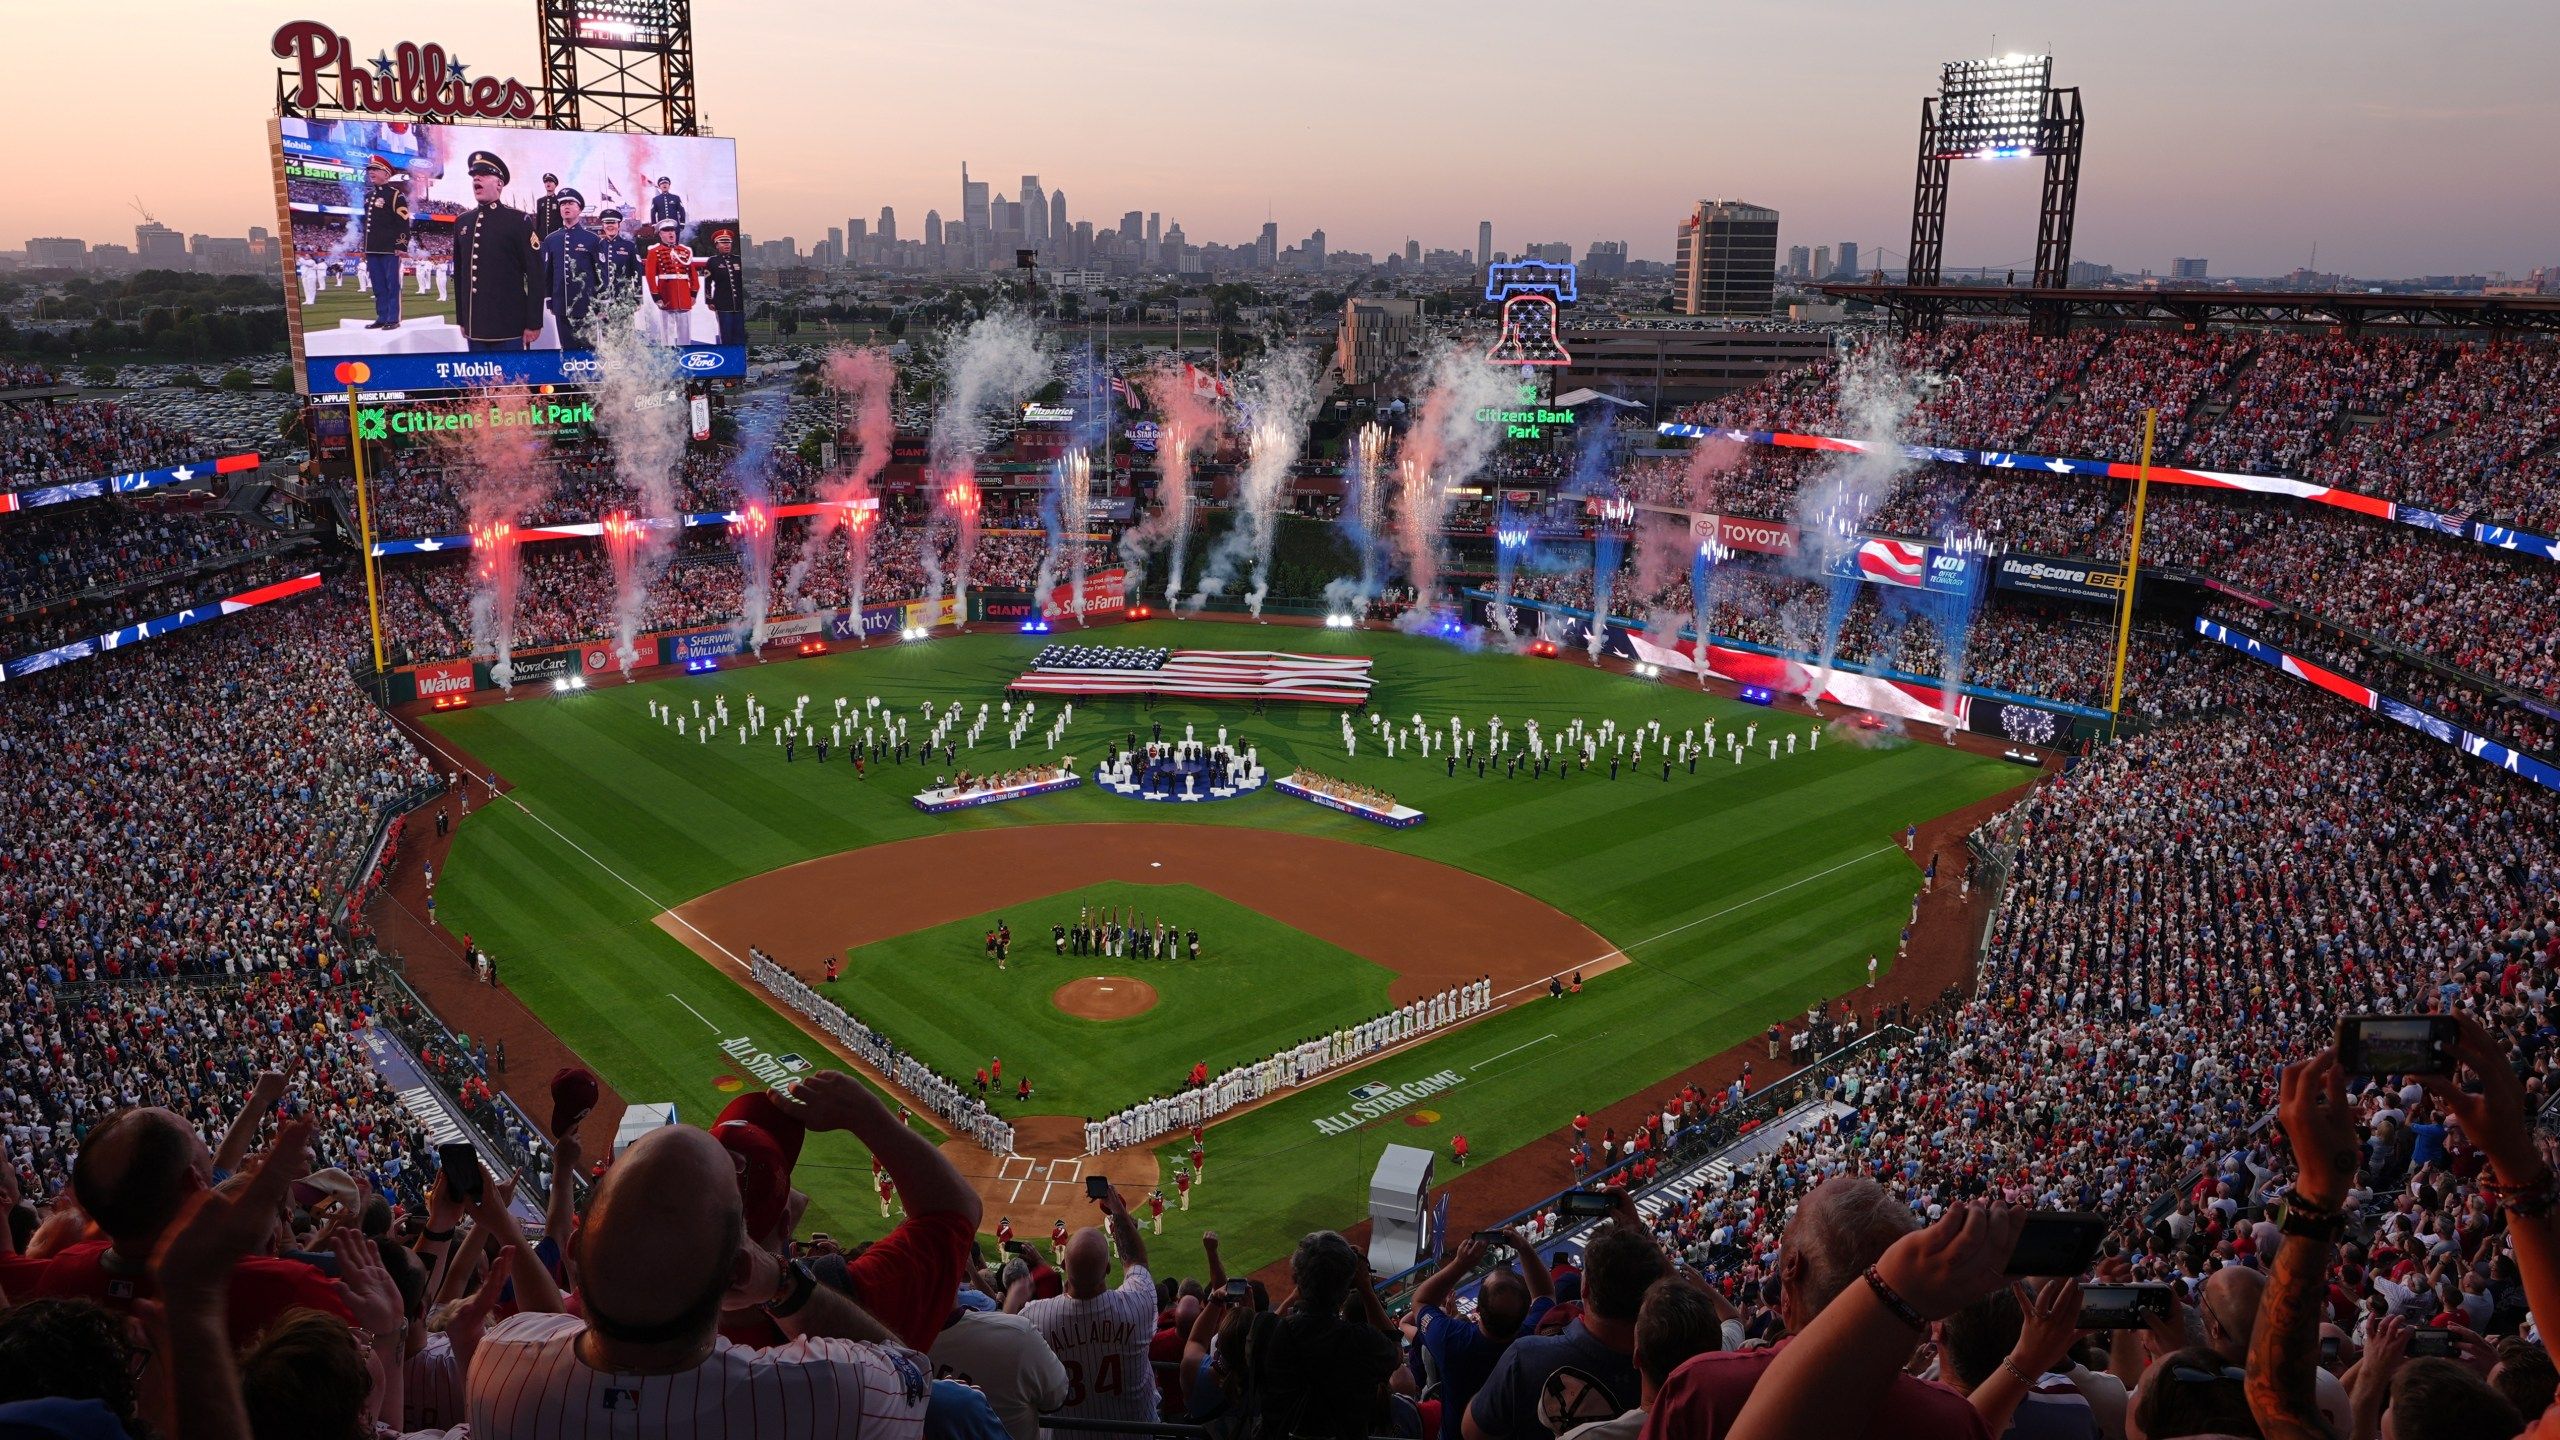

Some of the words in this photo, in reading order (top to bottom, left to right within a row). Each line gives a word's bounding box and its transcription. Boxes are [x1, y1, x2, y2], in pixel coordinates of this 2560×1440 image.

[271, 19, 537, 121] Phillies
[303, 166, 337, 181] Bank
[562, 358, 622, 372] abbvie
[687, 353, 716, 368] Ford
[453, 361, 503, 378] Mobile
[1025, 402, 1077, 417] Fitzpatrick
[1475, 408, 1536, 423] Citizens
[1537, 408, 1575, 424] Bank
[391, 410, 483, 433] Citizens
[489, 404, 545, 429] Bank
[547, 402, 596, 424] Park
[1508, 424, 1540, 439] Park
[895, 448, 928, 458] GIANT
[1295, 488, 1322, 496] TOYOTA
[1721, 523, 1792, 549] TOYOTA
[1938, 570, 1958, 579] OFFICE
[2002, 559, 2086, 583] theScore
[987, 605, 1031, 617] GIANT
[767, 621, 809, 636] Yuengling
[690, 633, 735, 647] SHERWIN
[774, 636, 803, 647] LAGER
[419, 676, 472, 694] Wawa
[1992, 691, 2012, 700] ibx.com
[2034, 699, 2069, 711] Independence
[2085, 708, 2106, 718] ibx.com
[717, 1036, 758, 1060] ALL
[740, 1053, 789, 1083] STAR
[1311, 1111, 1367, 1137] ALL
[1351, 1090, 1417, 1119] STAR
[1400, 1069, 1467, 1099] GAME
[397, 1086, 474, 1146] AMERICAN
[1050, 1320, 1137, 1354] ALLADAY
[1061, 1353, 1124, 1408] 34
